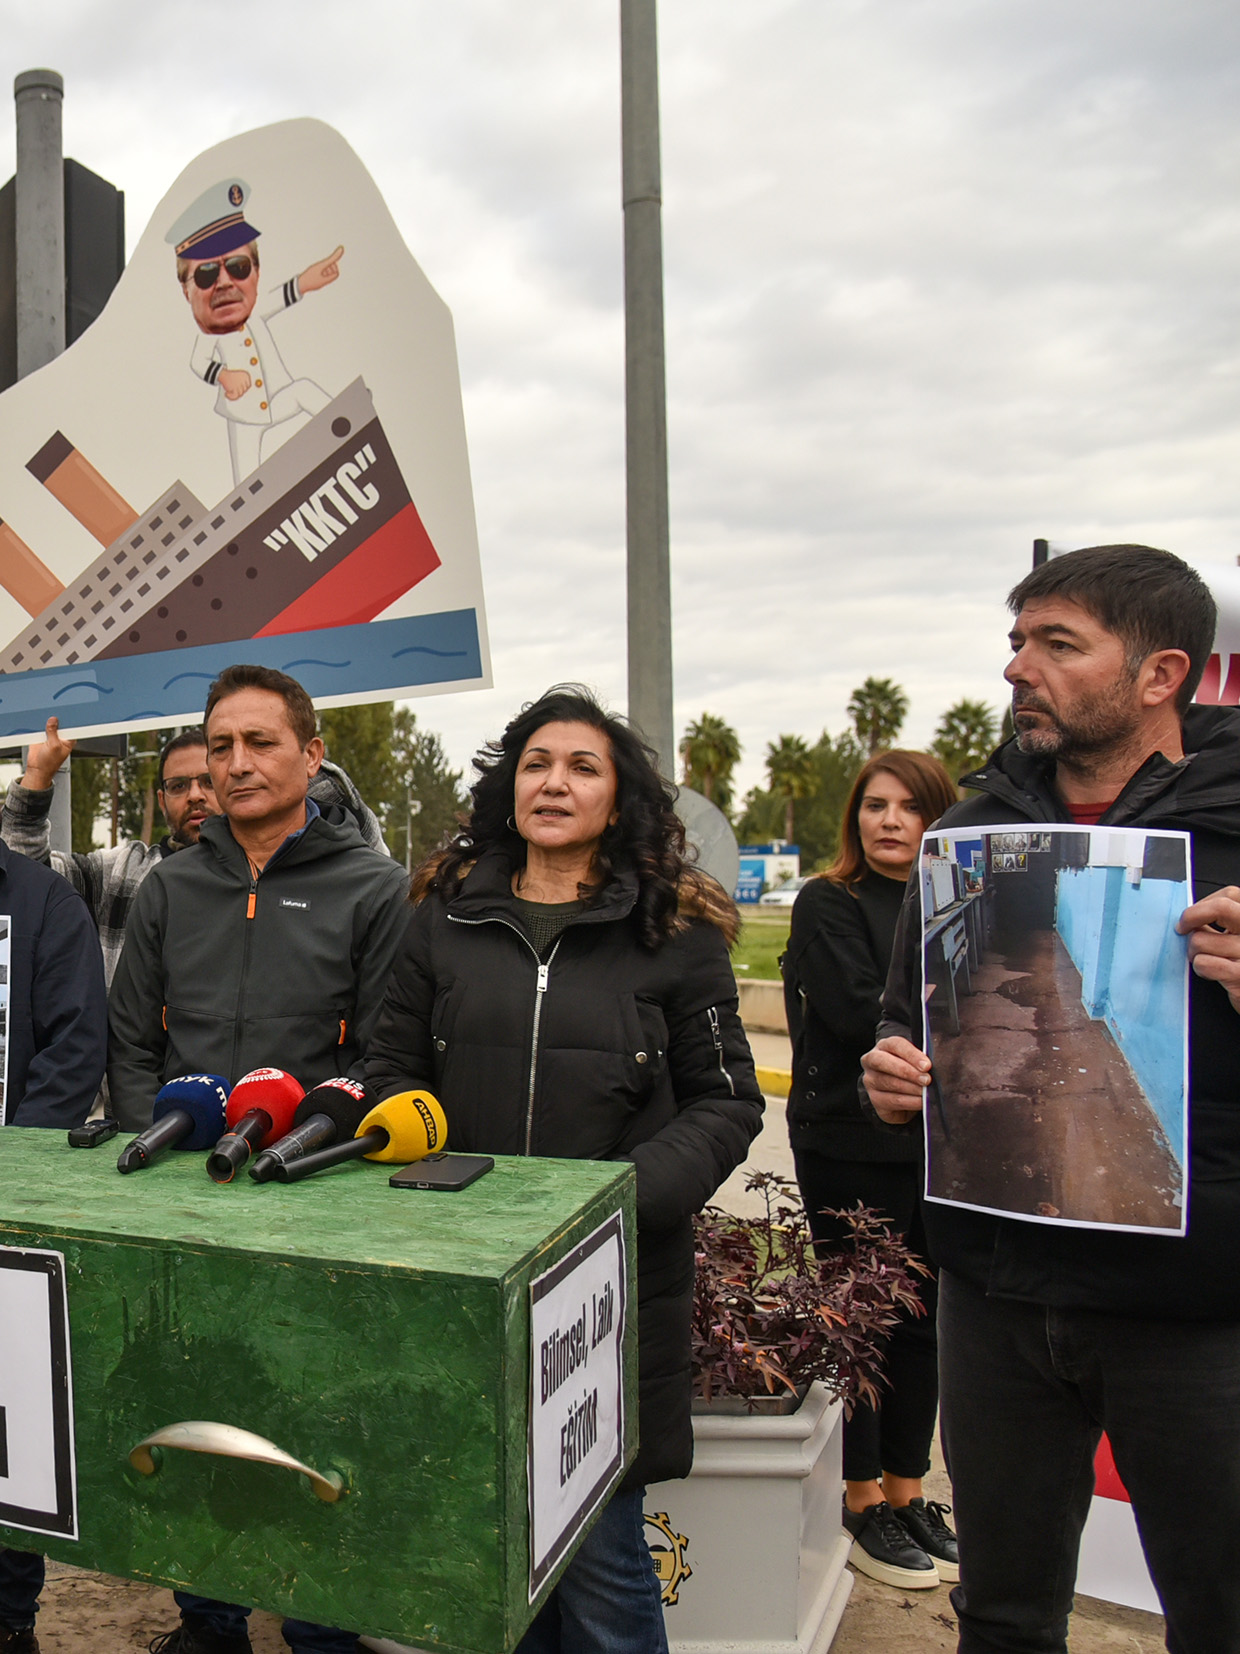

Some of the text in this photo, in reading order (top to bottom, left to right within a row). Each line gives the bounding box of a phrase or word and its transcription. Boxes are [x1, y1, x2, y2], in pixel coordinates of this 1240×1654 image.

[263, 443, 380, 562] "KKTC"
[540, 1280, 614, 1407] Bilimsel, Laik
[560, 1386, 598, 1489] EĞİTİM
